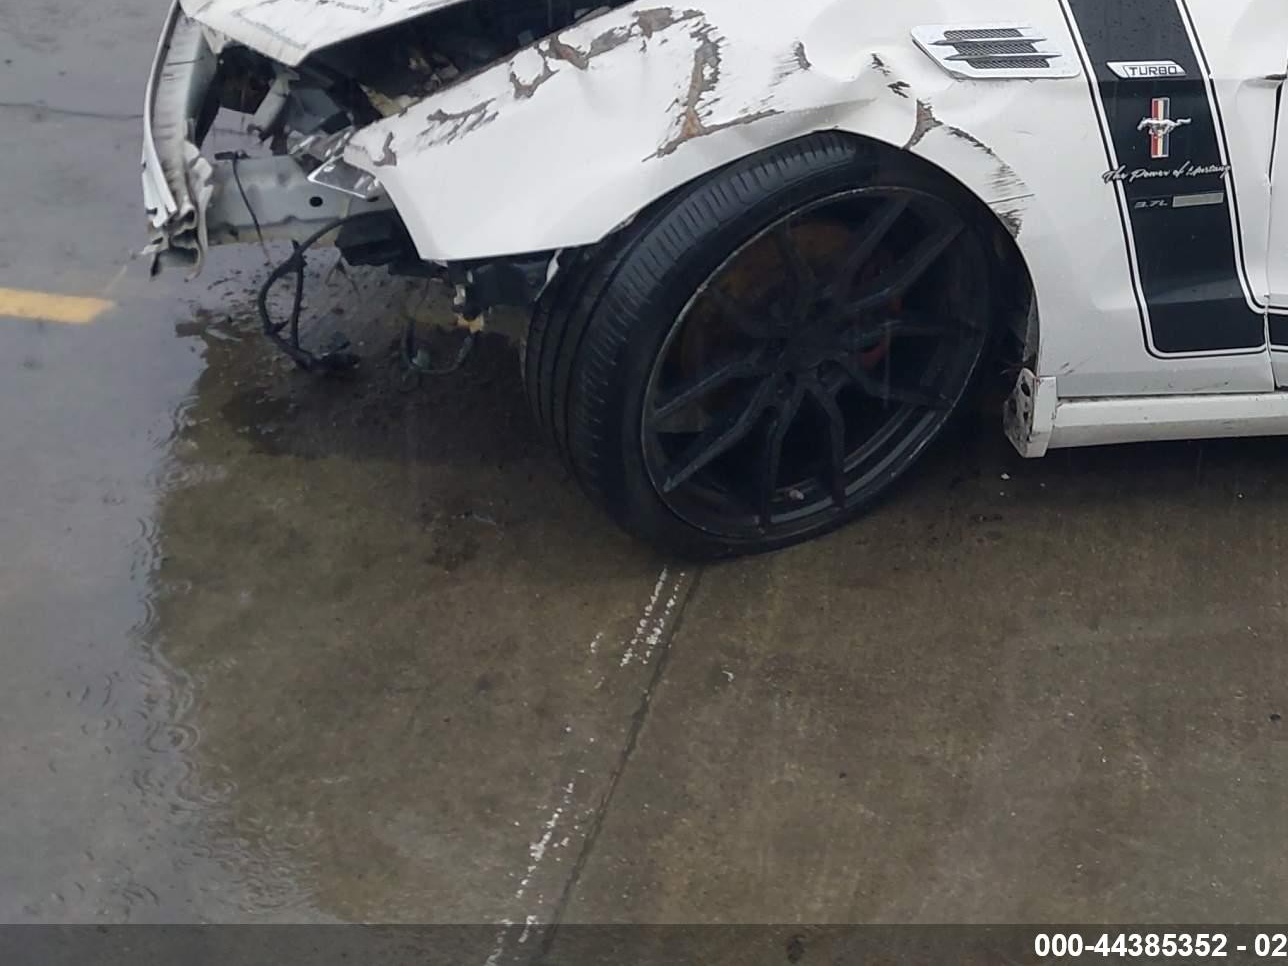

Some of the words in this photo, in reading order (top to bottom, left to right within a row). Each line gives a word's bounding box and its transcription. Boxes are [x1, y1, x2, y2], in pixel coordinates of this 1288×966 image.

[1128, 65, 1177, 76] TURBO
[1101, 164, 1129, 184] The
[1128, 168, 1170, 183] Power
[1172, 160, 1191, 179] of
